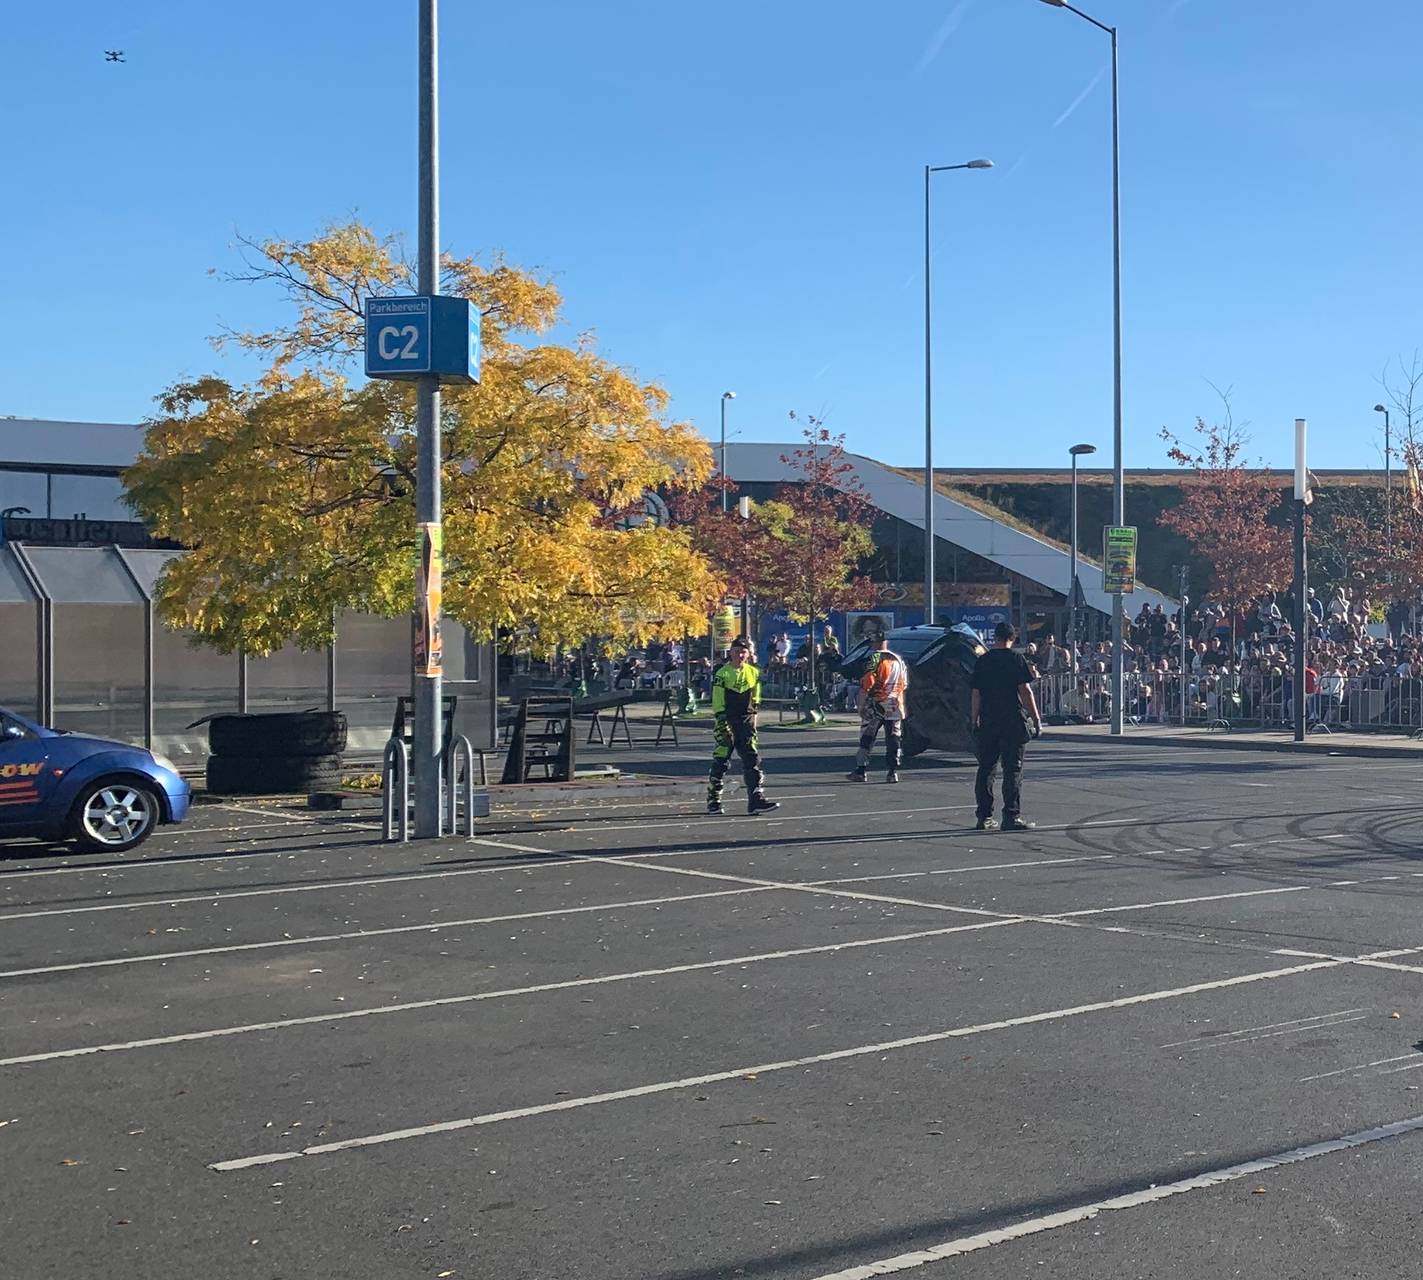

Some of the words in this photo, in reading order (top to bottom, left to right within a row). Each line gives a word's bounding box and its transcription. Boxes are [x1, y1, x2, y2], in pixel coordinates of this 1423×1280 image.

[369, 302, 427, 313] Parkbereich
[378, 325, 419, 360] C2
[962, 613, 986, 622] Apollo
